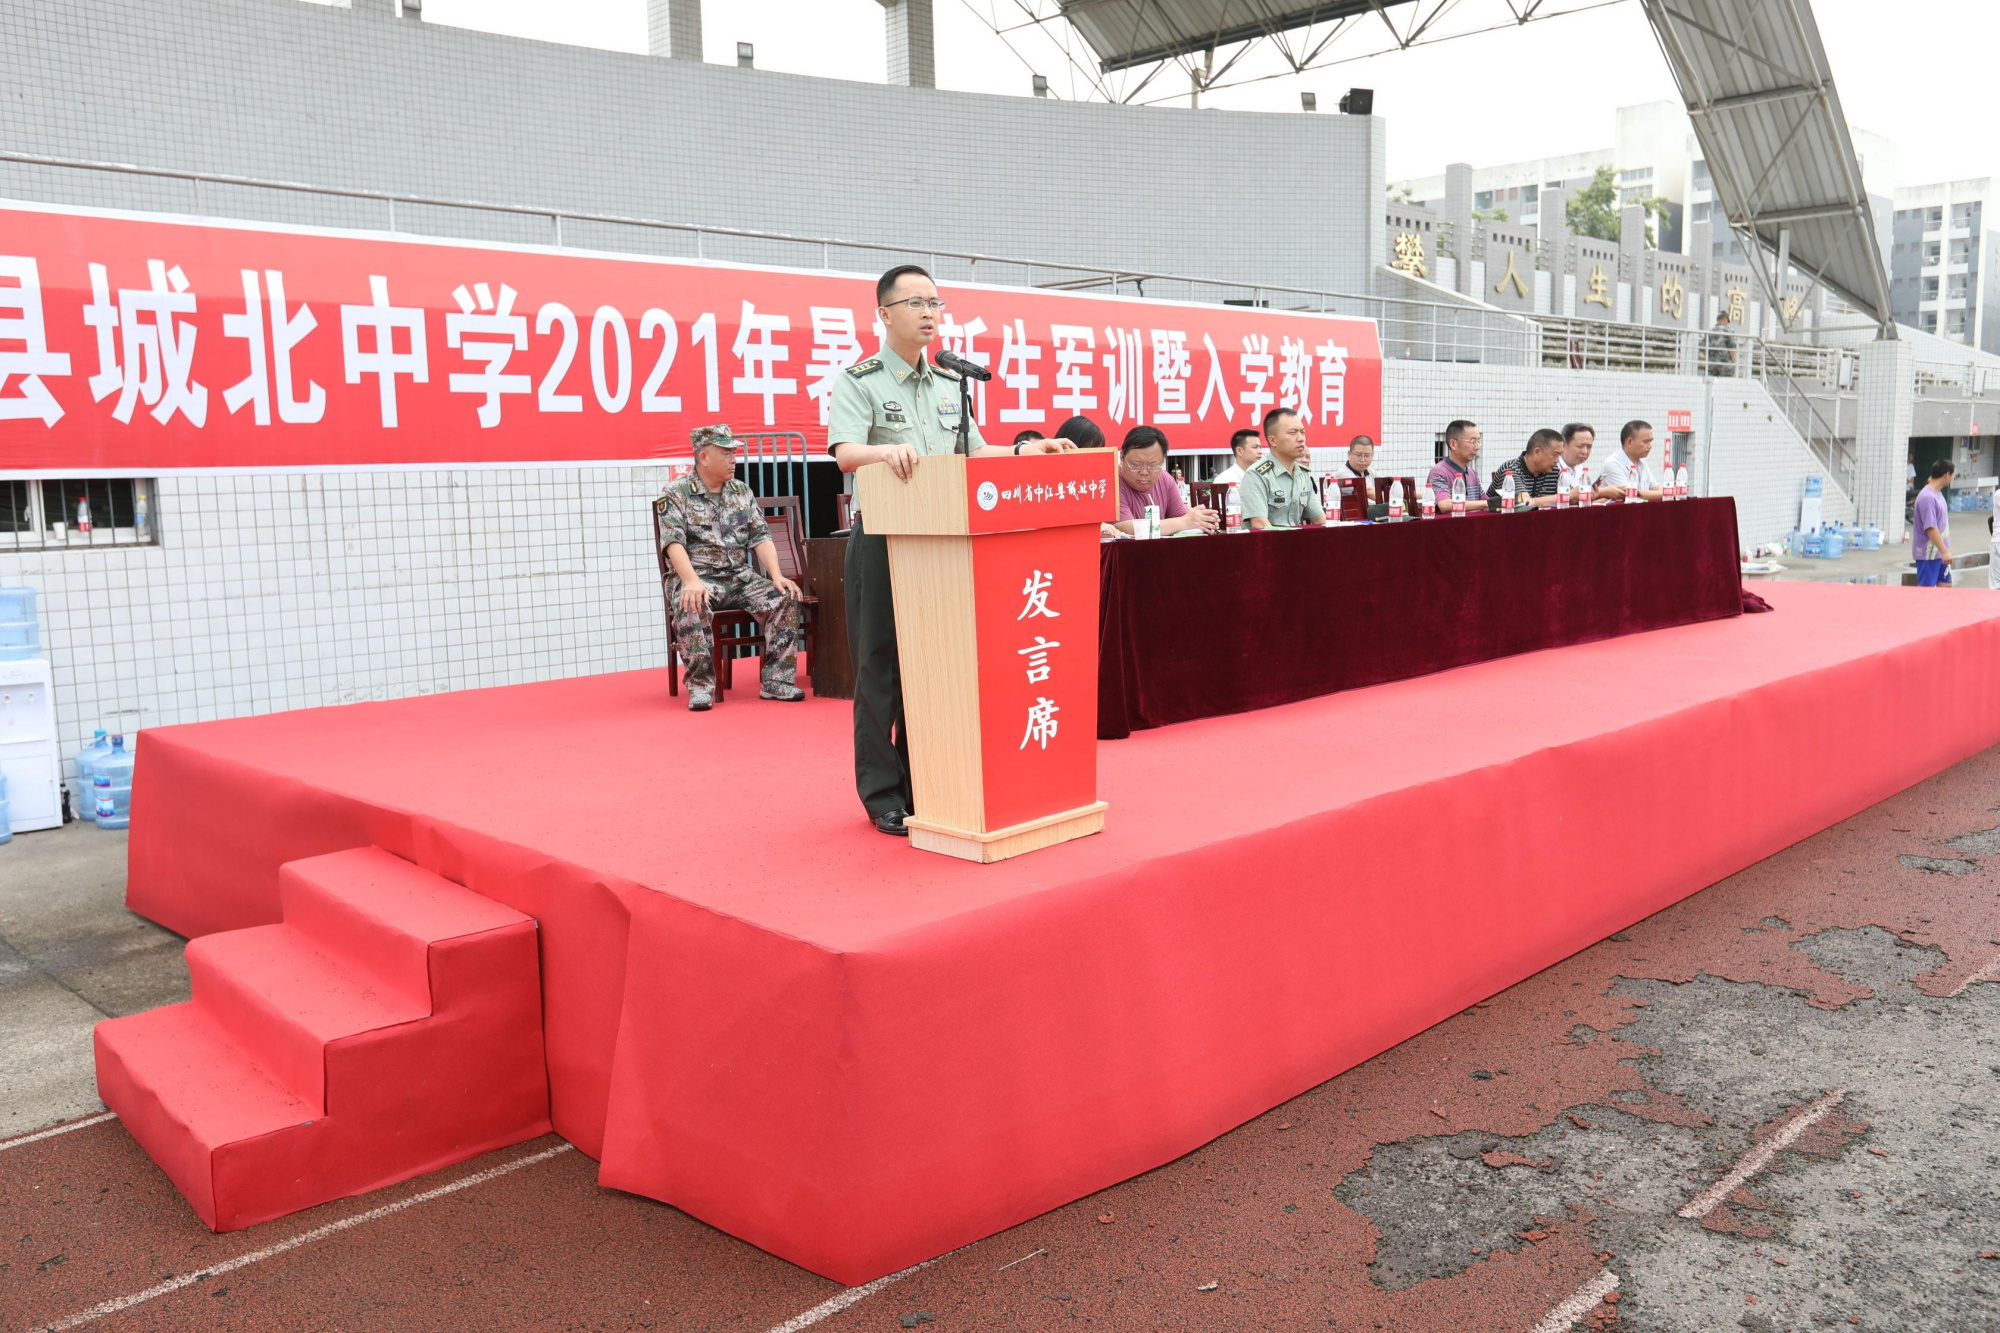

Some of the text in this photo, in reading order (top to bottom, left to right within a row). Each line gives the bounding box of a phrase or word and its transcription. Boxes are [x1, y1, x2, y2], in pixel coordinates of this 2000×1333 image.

[0, 255, 1349, 428] 县城北中学2021年暑新生军训暨入学教育
[1001, 478, 1107, 504] 四川省中江县城北中学
[1017, 569, 1061, 750] 发言席
